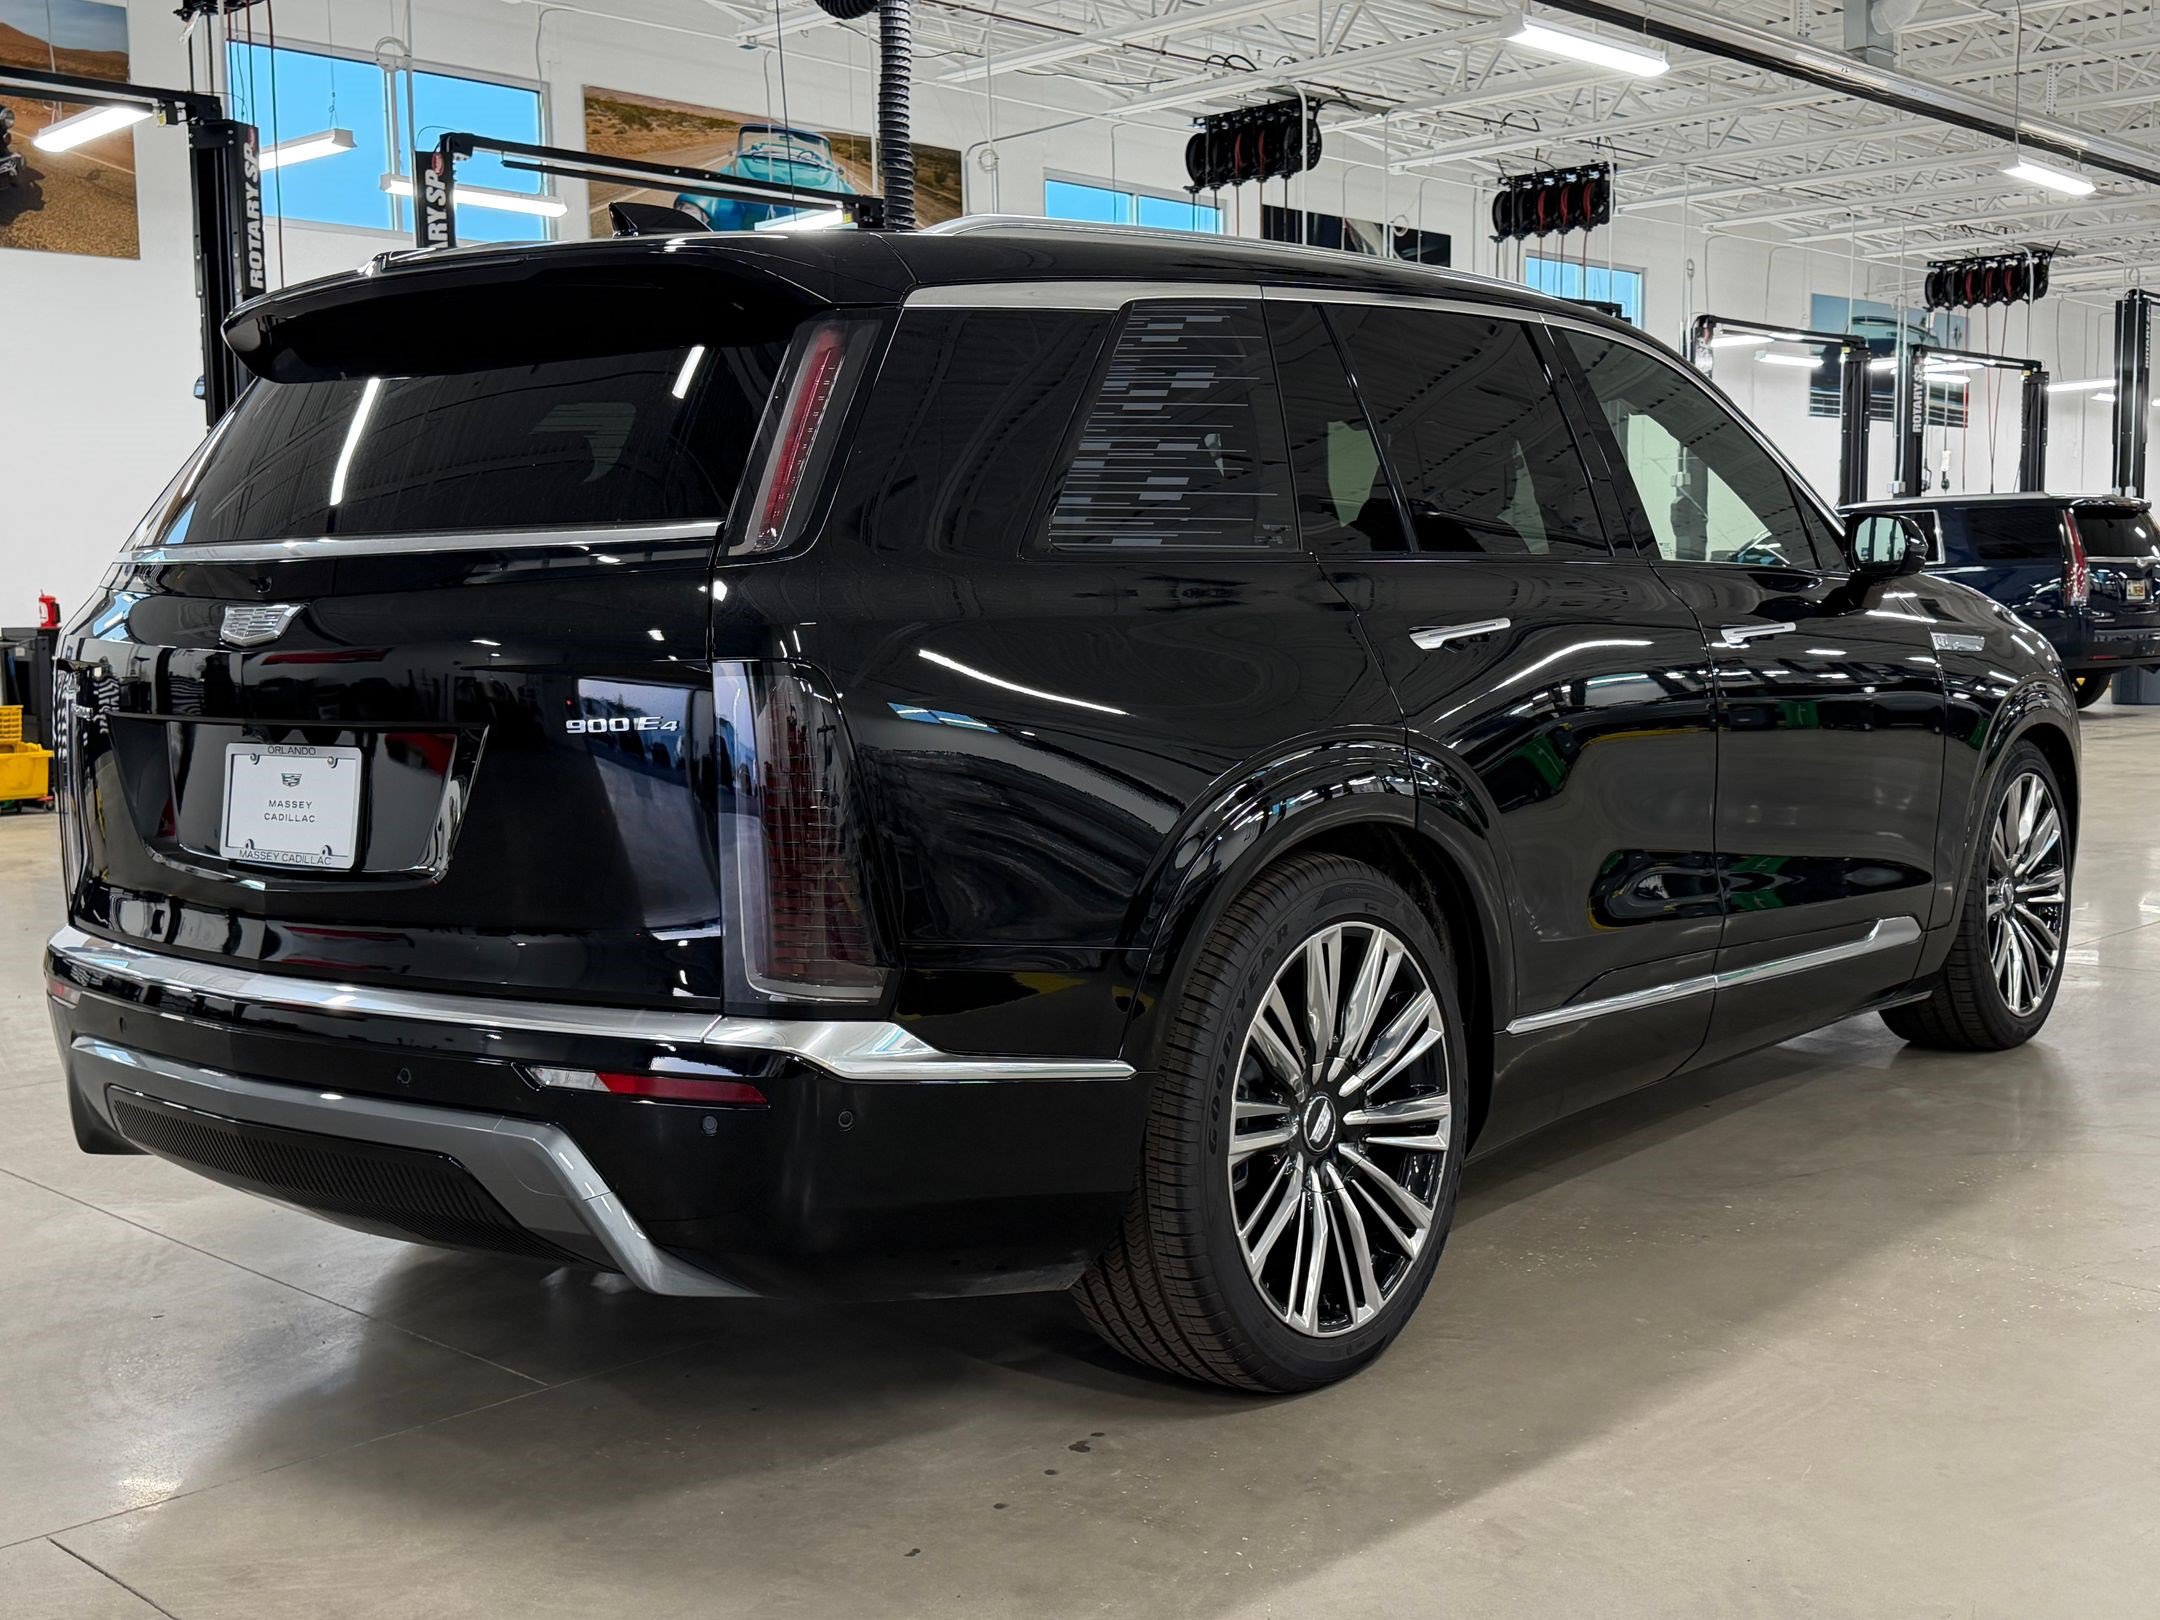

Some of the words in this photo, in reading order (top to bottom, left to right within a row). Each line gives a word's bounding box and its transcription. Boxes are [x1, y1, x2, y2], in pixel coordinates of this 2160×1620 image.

[244, 181, 264, 289] ROTARY
[1912, 383, 1923, 433] ROTARY
[565, 717, 630, 734] 900
[267, 745, 317, 756] ORLANDO
[268, 799, 313, 809] MASSEY
[264, 812, 316, 823] CADILLAC
[239, 849, 280, 861] MASSEY
[281, 853, 332, 865] CADILLAC
[1208, 922, 1289, 1155] GOODYEAR
